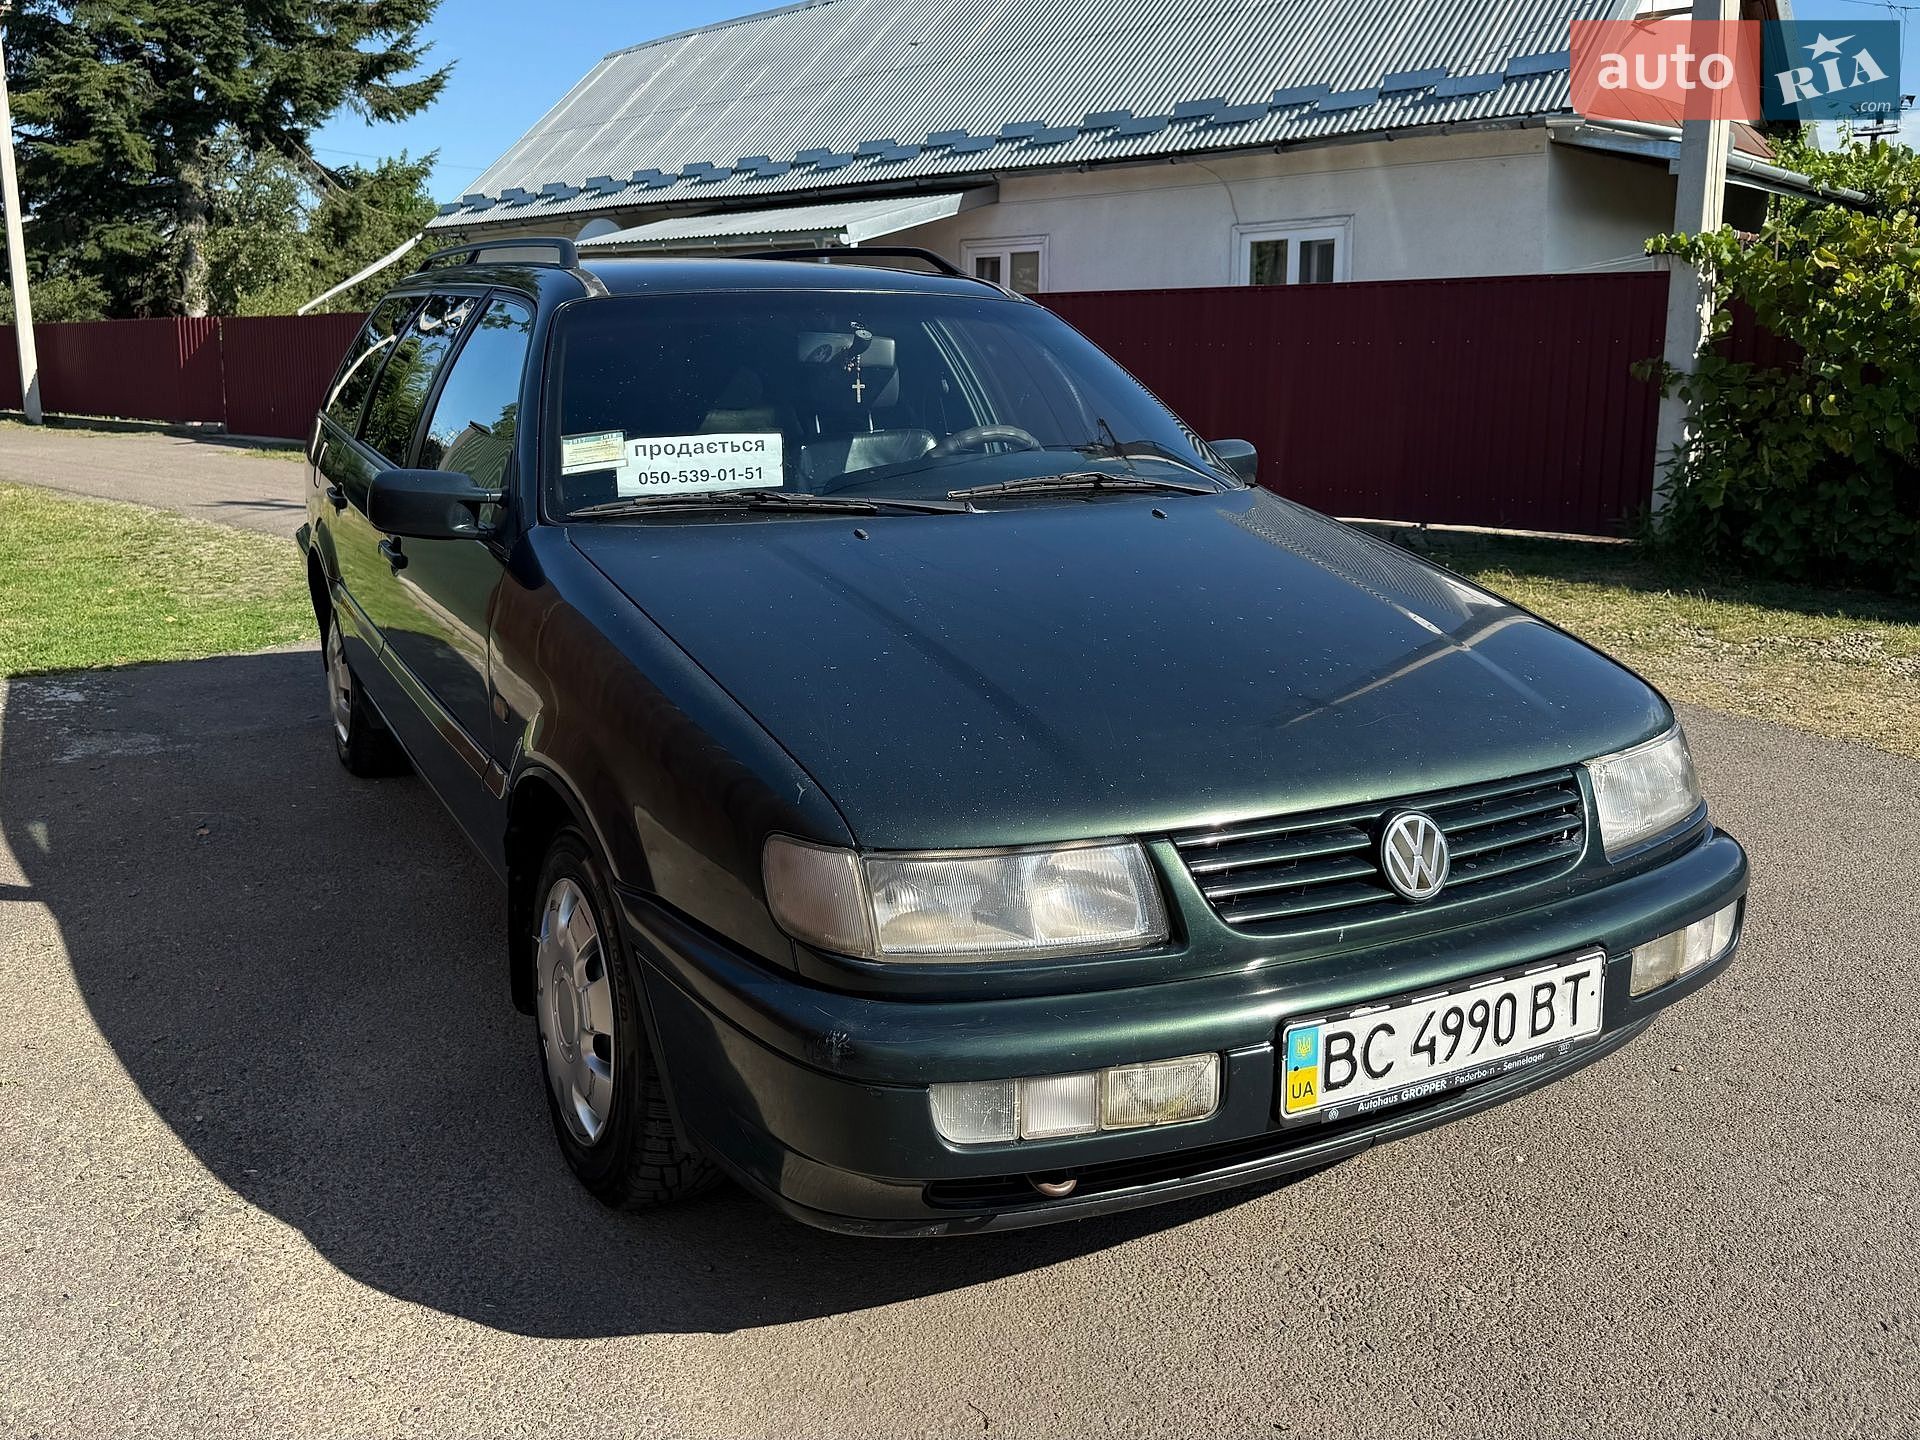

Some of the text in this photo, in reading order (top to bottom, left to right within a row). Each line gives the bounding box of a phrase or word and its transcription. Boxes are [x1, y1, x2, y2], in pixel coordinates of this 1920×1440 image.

[634, 438, 766, 460] продається
[638, 466, 764, 485] 050-539-01-51
[1411, 993, 1517, 1067] 4990
[1291, 1081, 1315, 1099] UA
[1357, 1094, 1399, 1112] Autohaus
[1401, 1079, 1448, 1101] GROPPER
[1502, 1051, 1546, 1072] Sennelager
